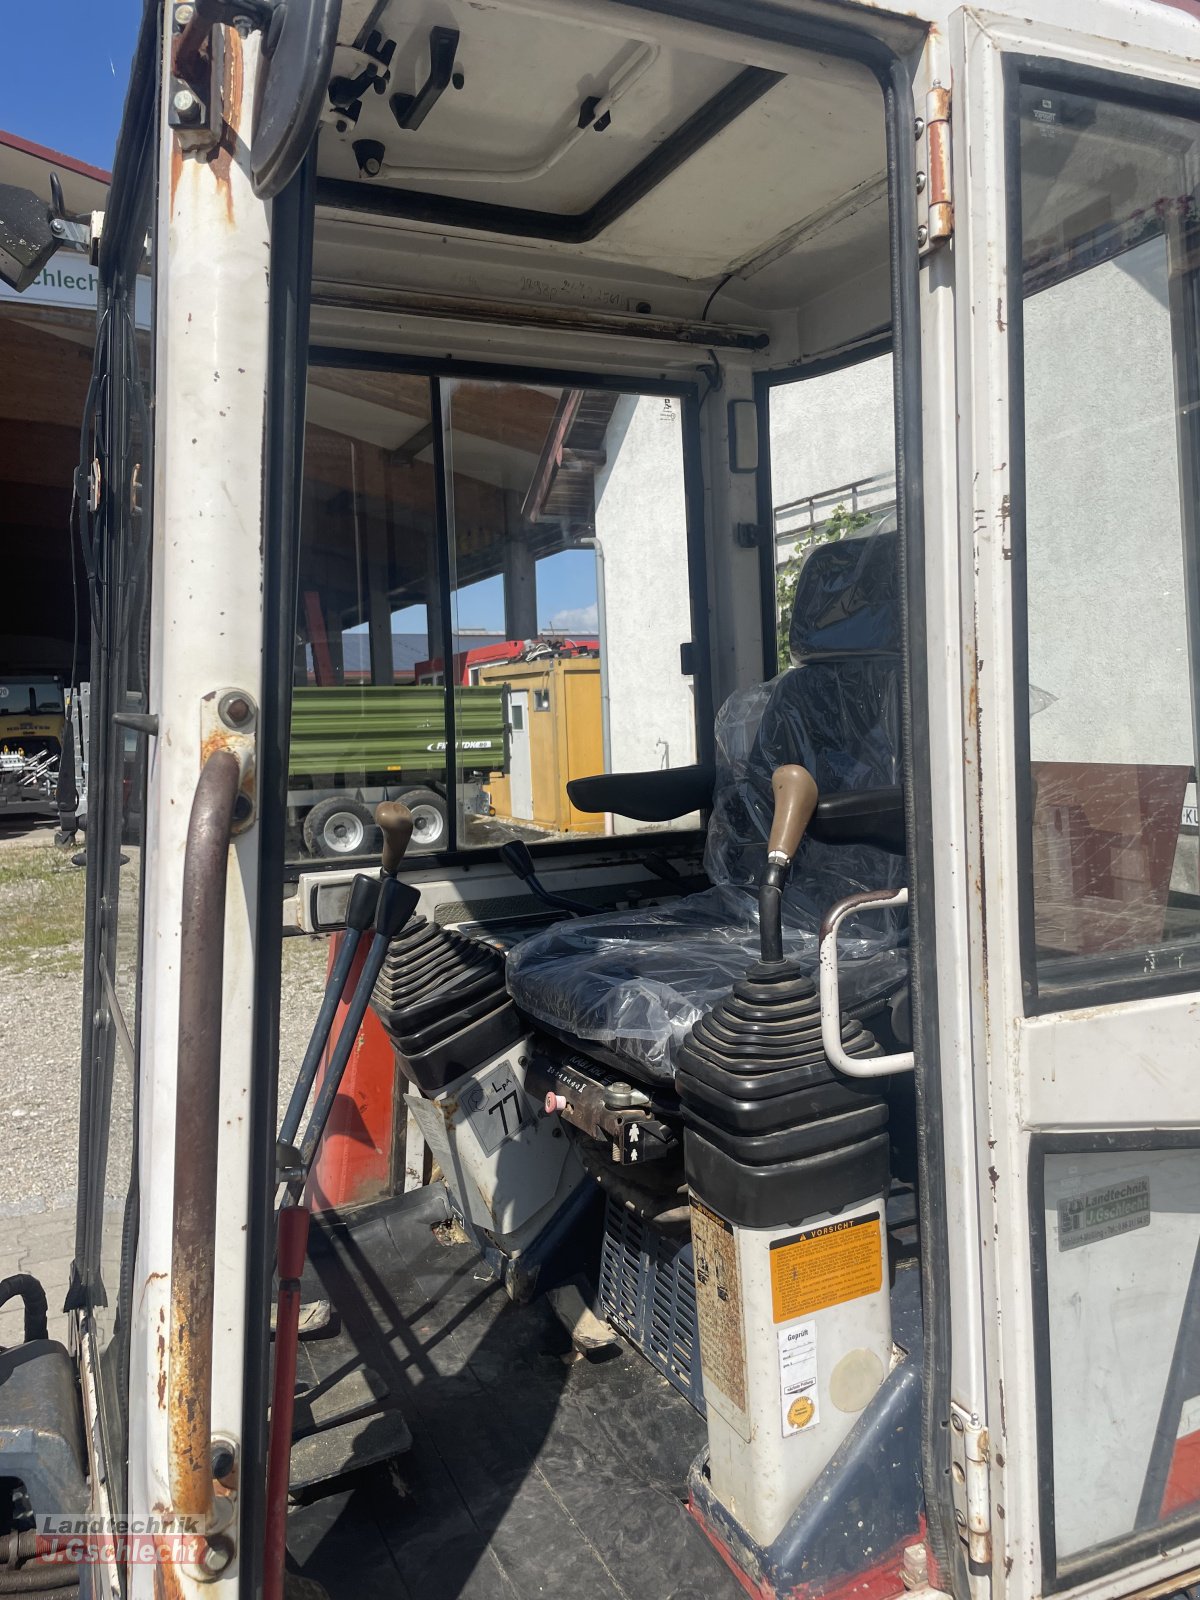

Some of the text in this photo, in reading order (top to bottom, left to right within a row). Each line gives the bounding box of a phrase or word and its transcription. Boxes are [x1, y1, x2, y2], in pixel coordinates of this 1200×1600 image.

[488, 1089, 523, 1136] 77
[1085, 1181, 1148, 1208] Landtechnik
[1087, 1195, 1149, 1226] J.Gschlecht
[811, 1220, 855, 1238] VORSICHT
